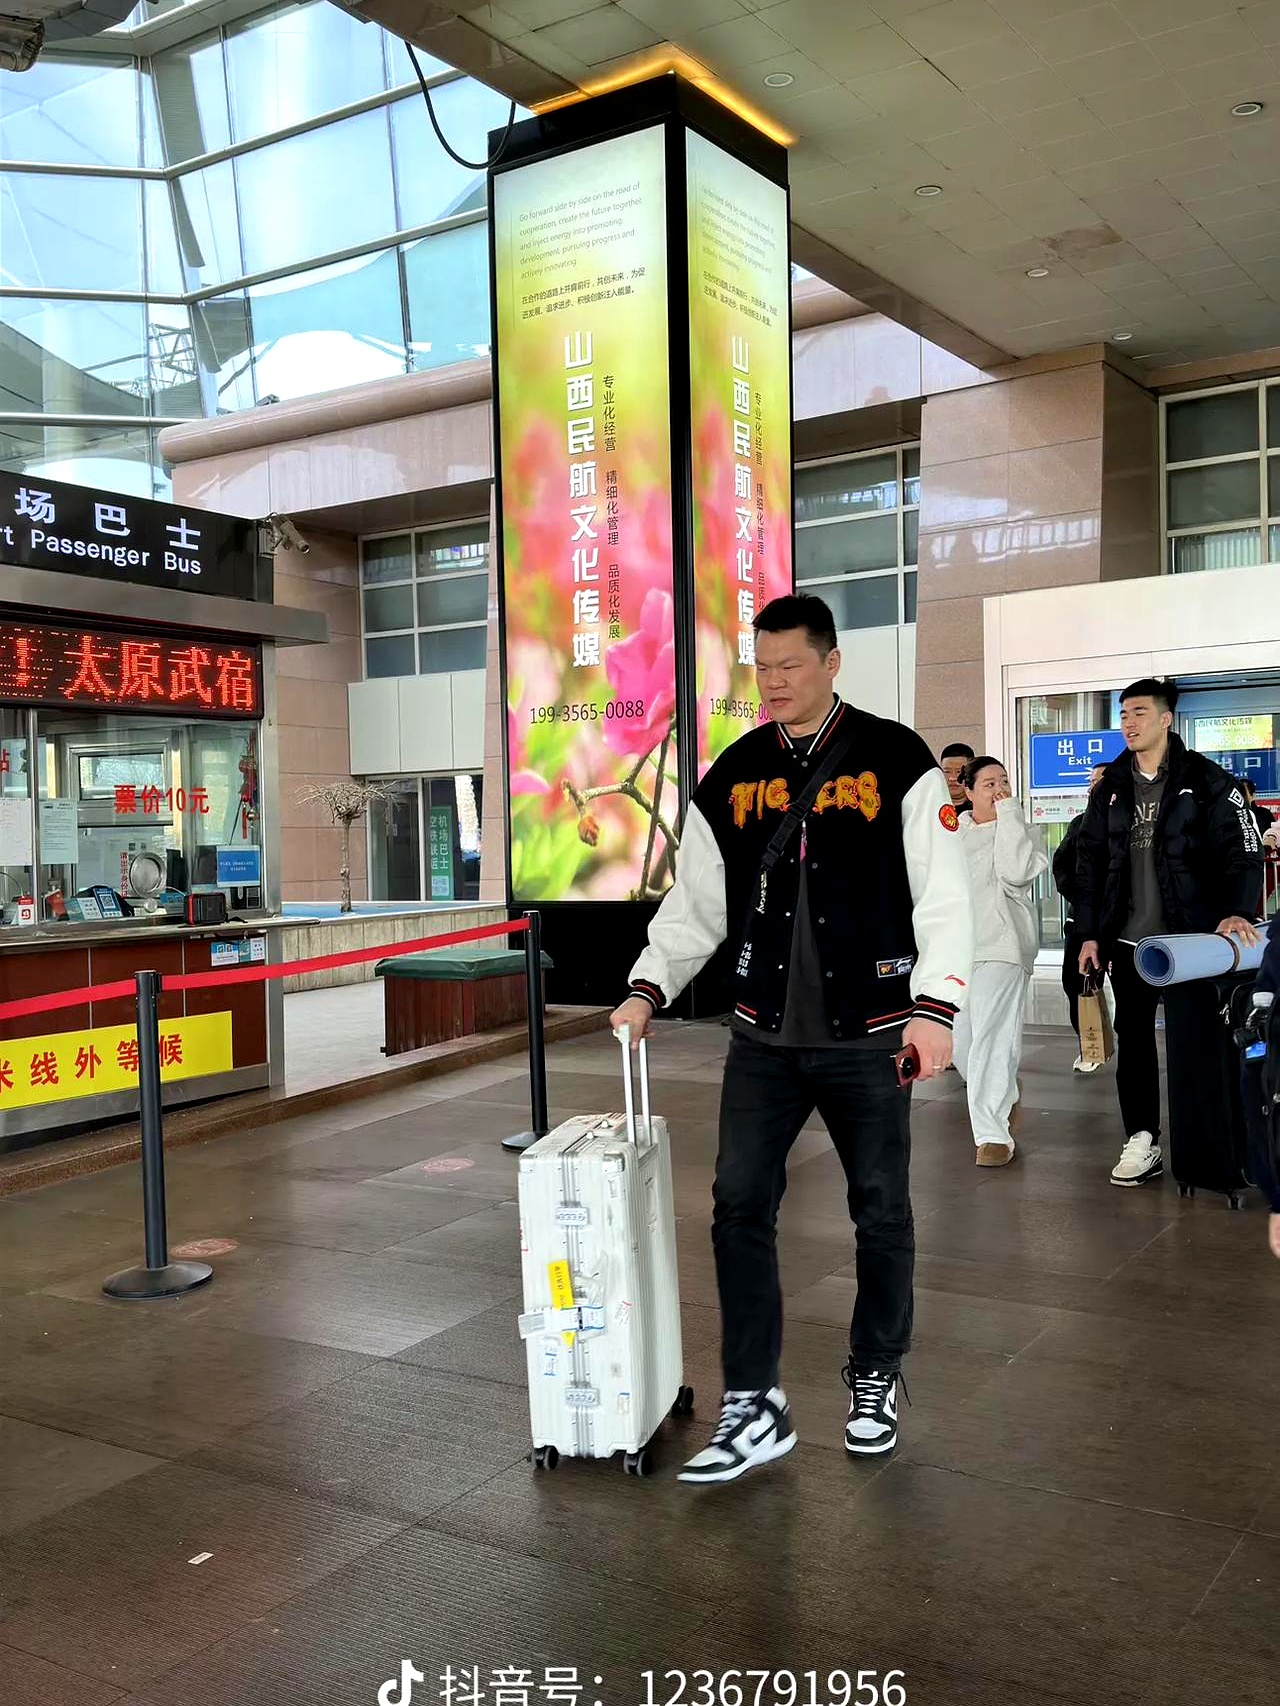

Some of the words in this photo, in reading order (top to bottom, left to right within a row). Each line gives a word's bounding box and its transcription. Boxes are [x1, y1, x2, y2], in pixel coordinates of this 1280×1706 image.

[520, 213, 528, 222] Go
[529, 206, 553, 219] forward
[569, 201, 576, 209] by
[603, 189, 614, 198] the
[632, 181, 640, 190] of
[558, 214, 578, 225] create
[591, 205, 611, 217] future
[520, 242, 531, 251] and
[591, 234, 620, 248] progress
[622, 228, 635, 239] and
[603, 375, 617, 452] 专业化经营
[565, 331, 600, 667] 山西民航文化传媒
[606, 470, 619, 546] 精细化管理
[732, 336, 755, 666] 山西民航文化传媒
[31, 528, 150, 567] Passenger
[164, 551, 201, 575] Bus
[607, 564, 620, 639] 品质化发展
[64, 635, 252, 708] 太原武宿
[530, 700, 645, 724] 199-3565-0088
[710, 698, 773, 720] 199-3565-00
[1058, 739, 1103, 756] 出口
[1068, 756, 1092, 766] Exit
[114, 785, 210, 815] 票价10元
